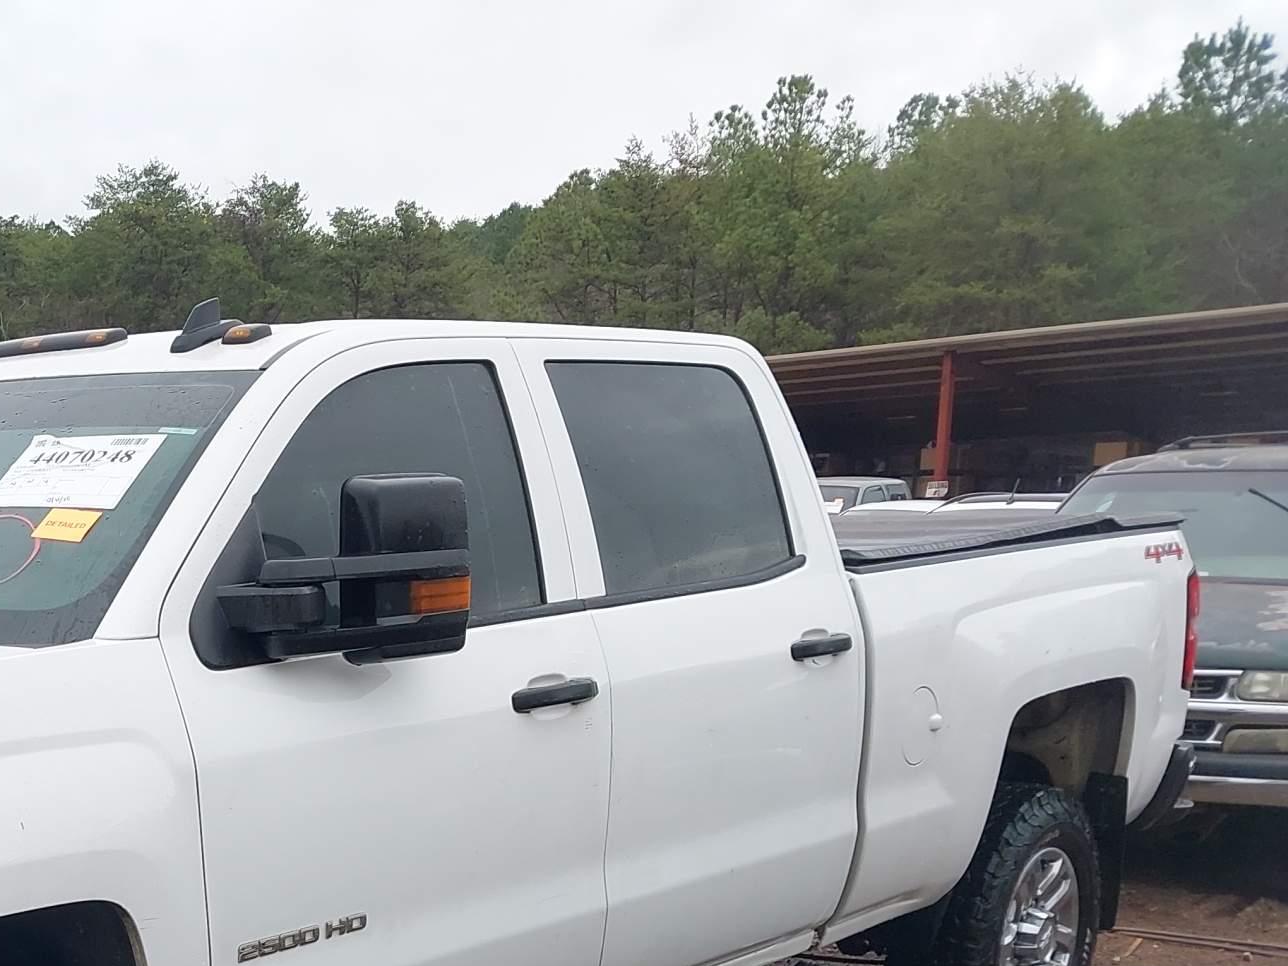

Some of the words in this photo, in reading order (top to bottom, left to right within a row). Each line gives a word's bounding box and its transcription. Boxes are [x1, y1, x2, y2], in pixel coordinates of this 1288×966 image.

[28, 449, 136, 465] 44070248
[44, 520, 87, 530] DETAILED
[237, 925, 320, 964] 2500
[325, 911, 367, 940] HD
